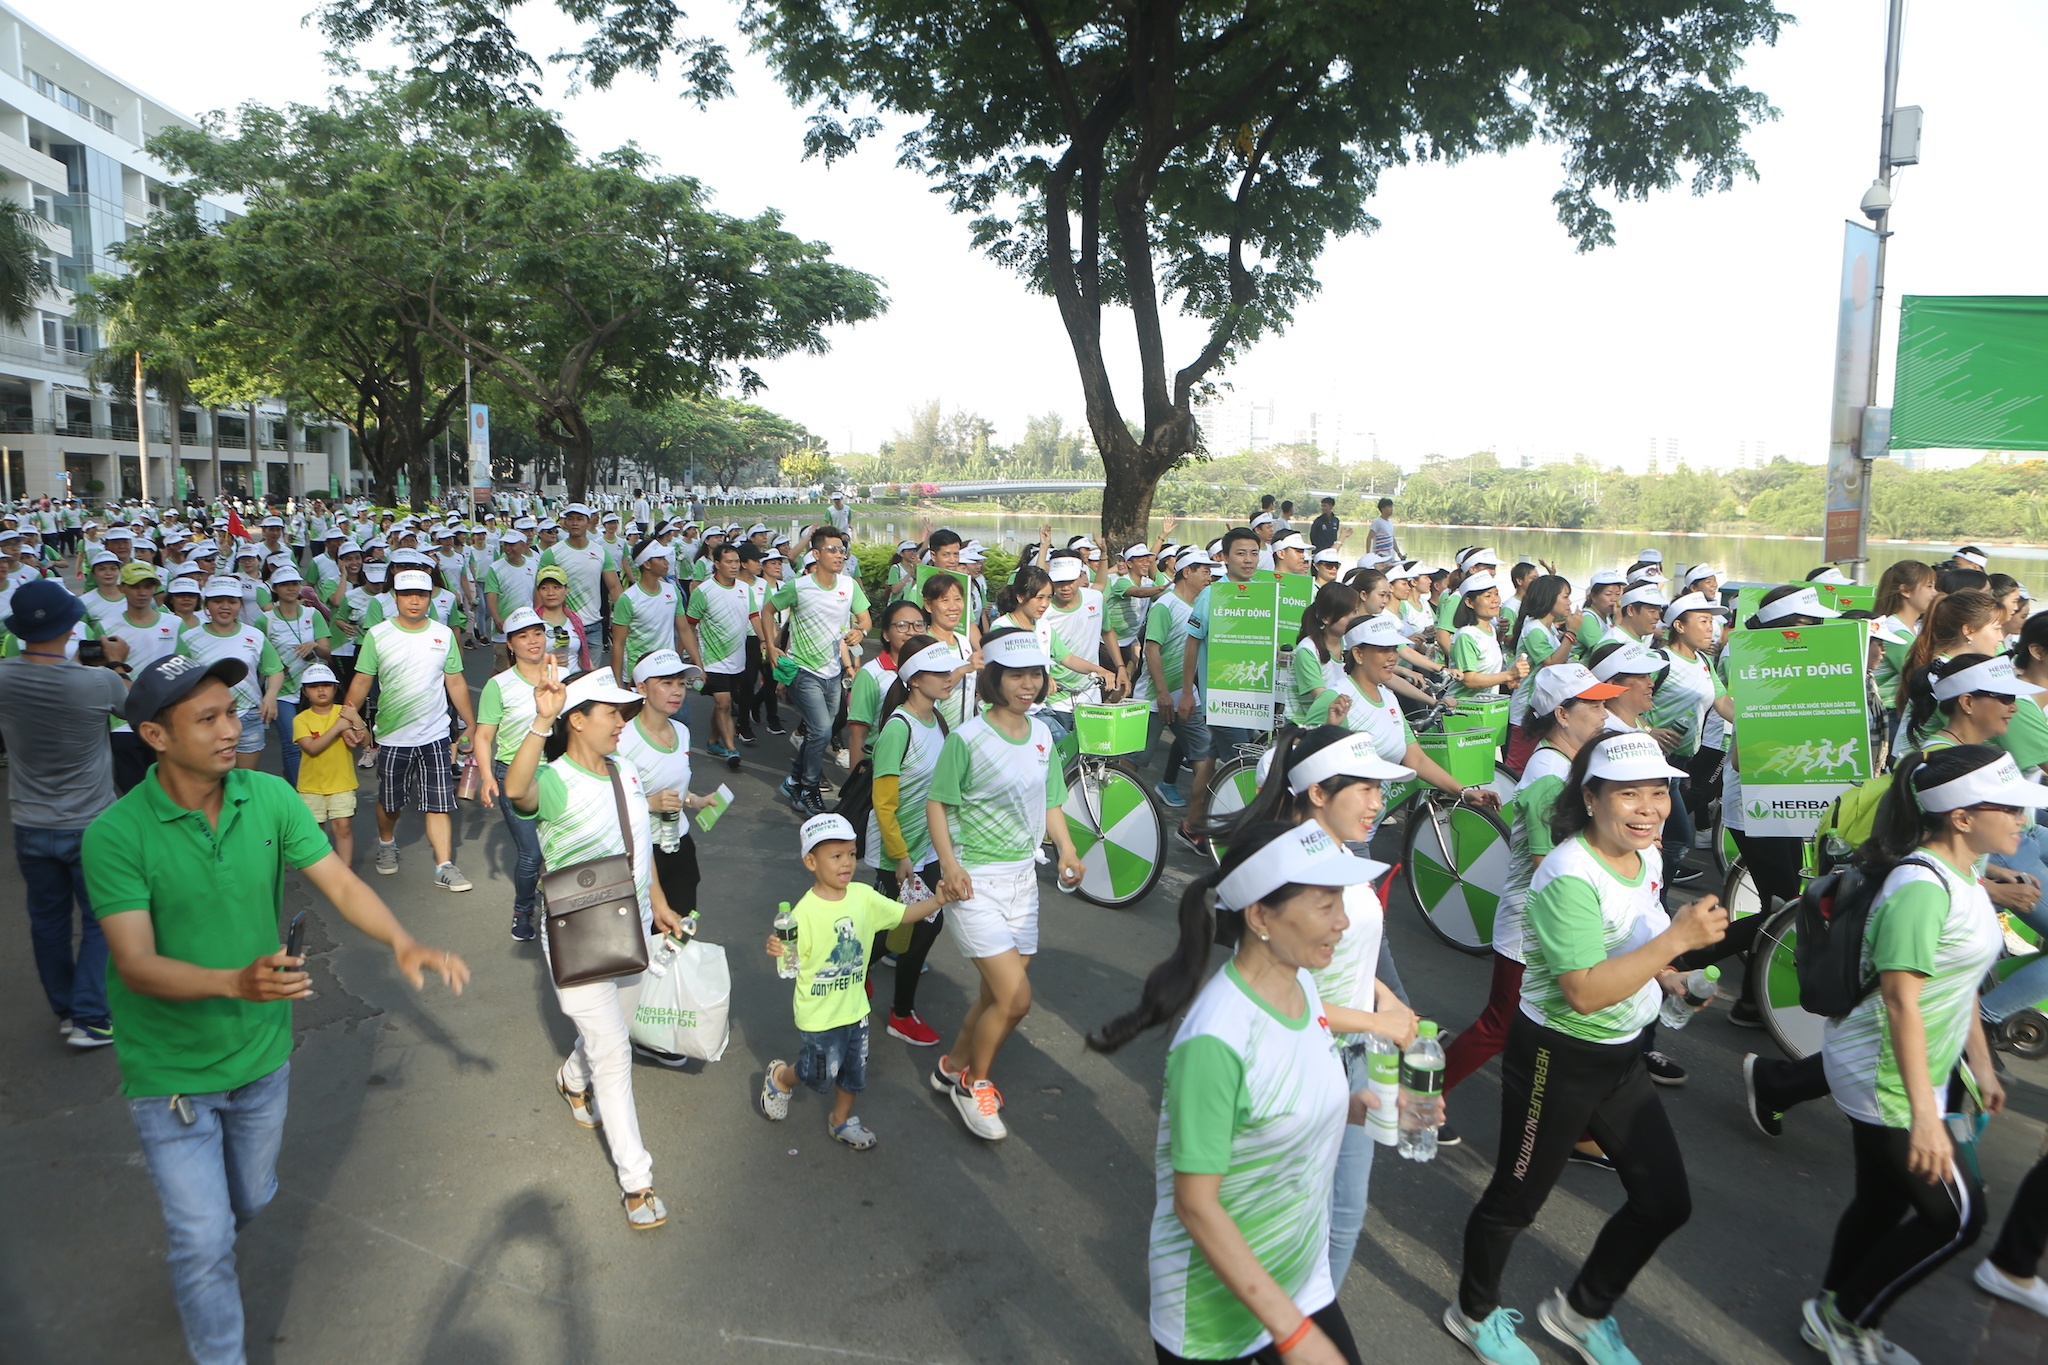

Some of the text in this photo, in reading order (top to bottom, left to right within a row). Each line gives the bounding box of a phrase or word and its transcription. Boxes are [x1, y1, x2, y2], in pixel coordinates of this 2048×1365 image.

[1282, 596, 1306, 608] ĐỘNG
[1214, 606, 1271, 619] LỄ PHÁT ĐỘNG
[1740, 662, 1853, 680] LỄ PHÁT ĐỘNG
[1221, 701, 1270, 711] HERBALIFE
[1221, 707, 1270, 718] NUTRITION
[1465, 734, 1491, 742] HERBALIFE
[1465, 738, 1492, 746] NUTRITION
[1772, 800, 1830, 809] HERBA
[805, 819, 838, 833] HERBALIFE
[808, 824, 839, 838] NUTRITION
[569, 888, 613, 908] VERSACE
[852, 970, 863, 985] THE
[637, 1004, 697, 1019] HERBALIFE
[635, 1013, 697, 1028] NUTRITION
